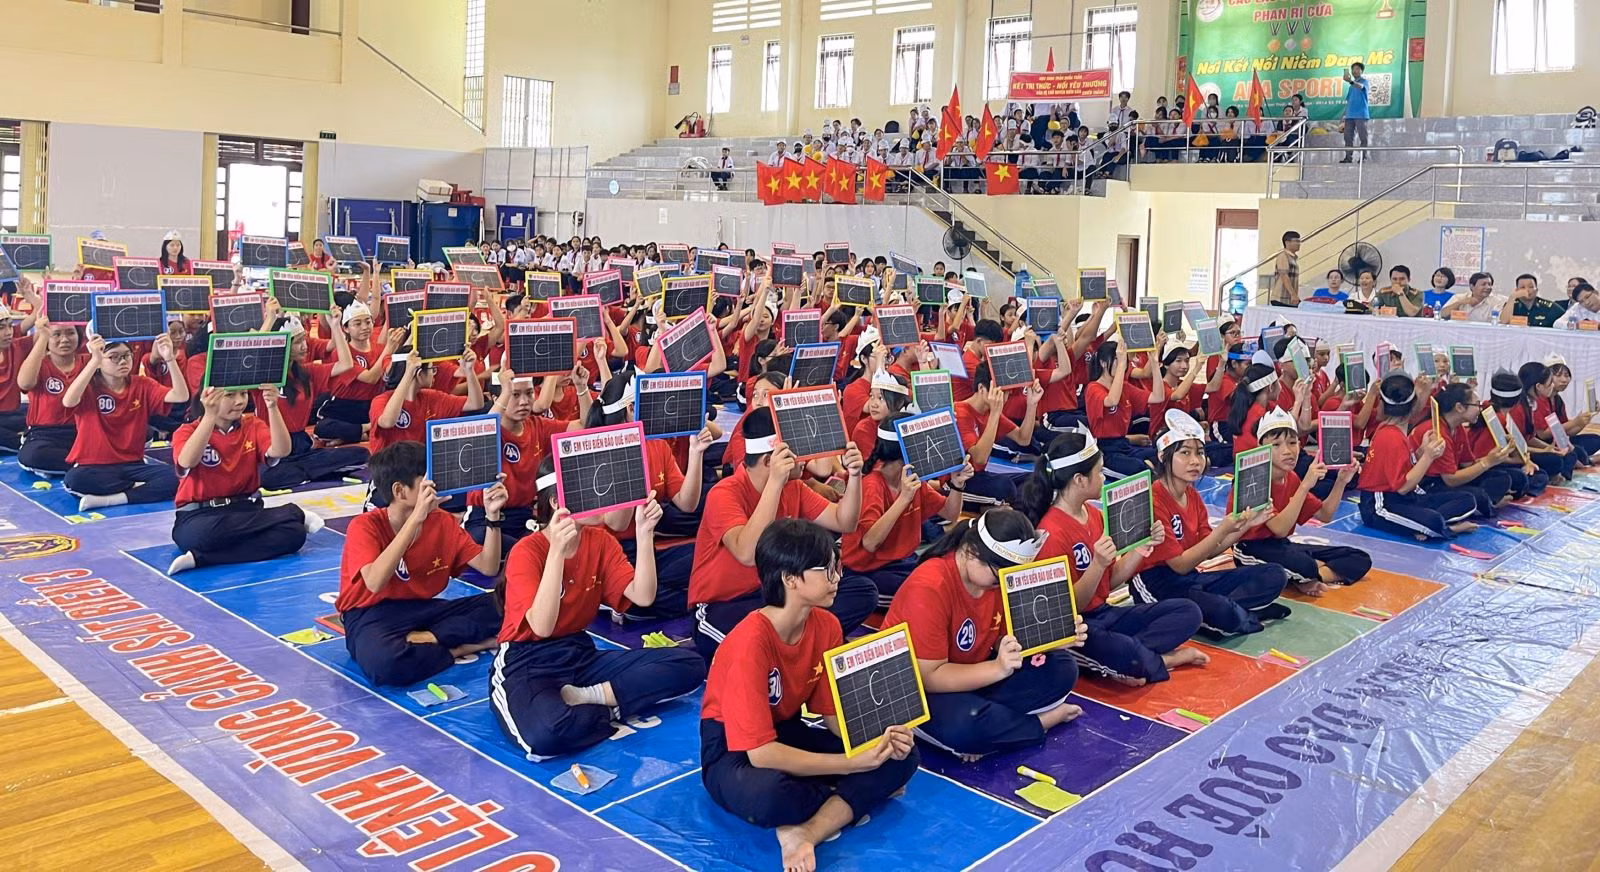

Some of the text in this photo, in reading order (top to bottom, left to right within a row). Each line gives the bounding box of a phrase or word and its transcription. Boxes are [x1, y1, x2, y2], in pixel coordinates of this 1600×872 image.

[1278, 76, 1343, 99] SPORT
[14, 245, 41, 267] C
[256, 244, 269, 260] C
[340, 245, 350, 255] C
[387, 246, 396, 257] A
[128, 267, 149, 286] C
[471, 271, 484, 282] C
[719, 276, 728, 288] C
[782, 266, 793, 280] C
[289, 282, 309, 300] C
[538, 282, 549, 297] C
[646, 278, 659, 292] C
[848, 286, 858, 300] C
[923, 284, 936, 302] C
[1088, 279, 1095, 290] C
[64, 295, 86, 315] C
[175, 288, 192, 307] C
[676, 290, 692, 310] C
[114, 306, 139, 335] C
[229, 306, 249, 325] C
[1037, 308, 1050, 328] C
[1169, 314, 1175, 326] C
[794, 321, 805, 345] C
[891, 316, 901, 337] C
[1130, 324, 1144, 344] C
[431, 328, 448, 354] C
[534, 337, 551, 356] C
[682, 338, 700, 361] C
[242, 355, 254, 368] C
[1006, 358, 1022, 379] C
[1460, 358, 1466, 370] C
[807, 366, 819, 385] C
[664, 396, 677, 415] C
[926, 386, 938, 409] C
[806, 414, 817, 438] D
[574, 441, 581, 452] EM
[925, 435, 945, 463] A
[1330, 443, 1341, 463] C
[458, 444, 473, 472] C
[593, 462, 614, 496] C
[1245, 472, 1257, 498] A
[1120, 499, 1135, 533] C
[1074, 546, 1090, 566] 28
[1015, 576, 1022, 587] EM
[1033, 594, 1048, 624] C
[960, 623, 973, 645] 29
[846, 656, 855, 668] EM
[128, 644, 279, 712] CẢNH
[769, 675, 781, 698] 30
[870, 670, 884, 706] C
[214, 699, 386, 787] VÙNG
[1167, 753, 1302, 840] QUÊ
